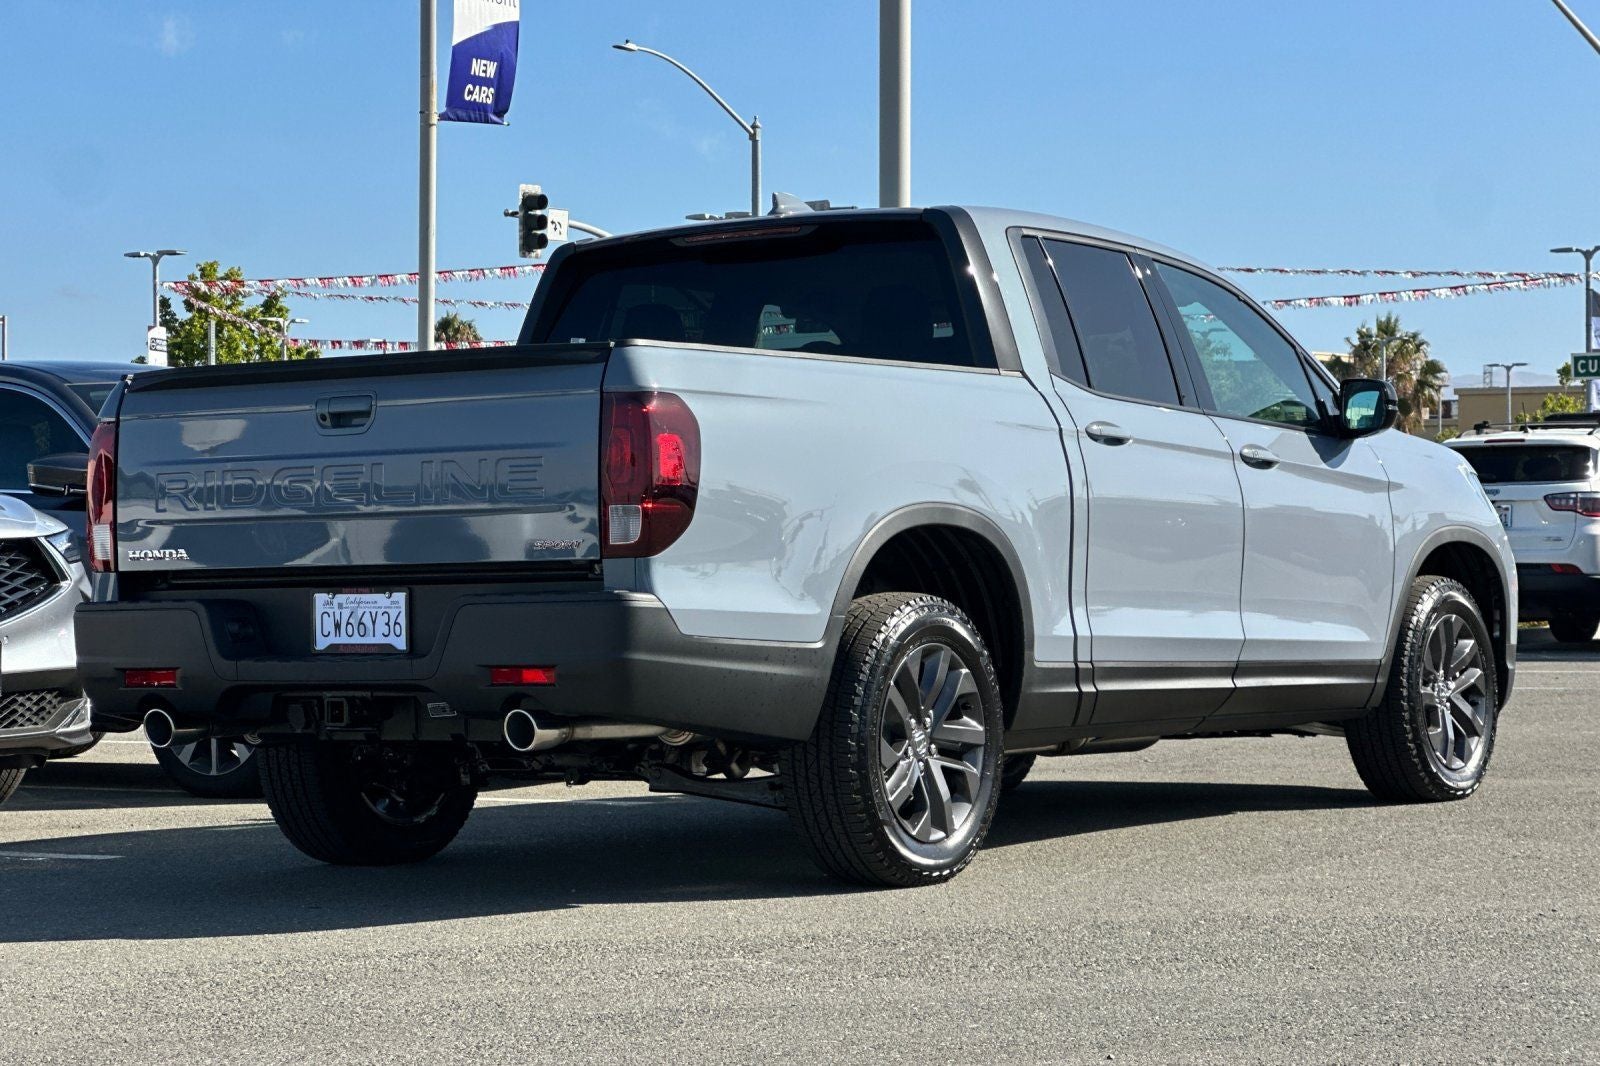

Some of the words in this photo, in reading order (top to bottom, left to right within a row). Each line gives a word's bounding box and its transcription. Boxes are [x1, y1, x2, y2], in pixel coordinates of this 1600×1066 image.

[471, 58, 497, 78] NEW
[464, 83, 494, 104] CARS
[155, 456, 545, 513] RIDGELINE
[128, 548, 190, 561] HONDA
[533, 539, 584, 550] SPORT
[345, 596, 378, 606] California
[320, 611, 402, 637] CW66Y36
